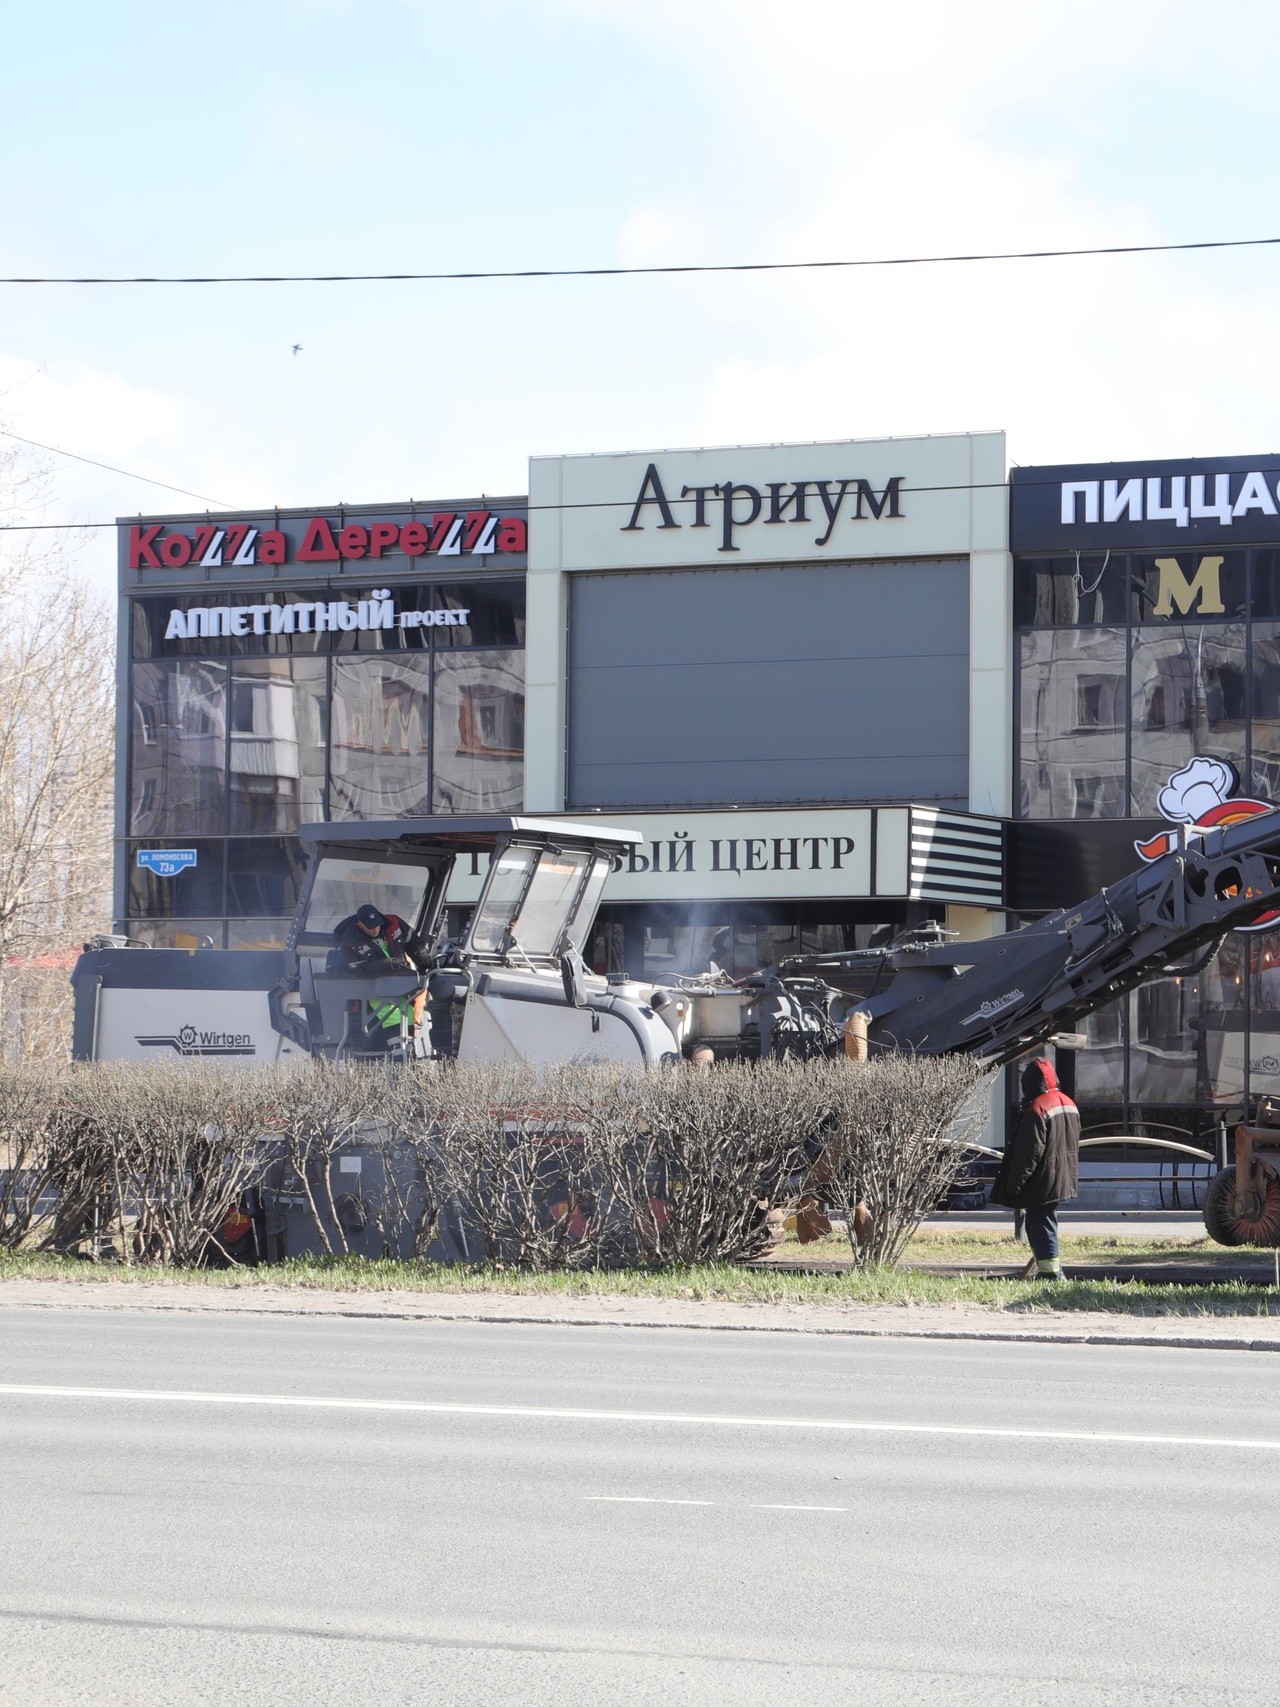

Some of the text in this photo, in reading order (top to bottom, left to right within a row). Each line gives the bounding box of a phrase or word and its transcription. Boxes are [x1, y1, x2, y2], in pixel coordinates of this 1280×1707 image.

[620, 463, 906, 552] Атриум
[164, 588, 471, 639] АППЕТИТНЫЙ ПРОЕКТ
[151, 853, 194, 862] ЛОМОНОСОВА
[709, 836, 856, 878] ЦЕНТР
[199, 1031, 251, 1048] Wirtgen
